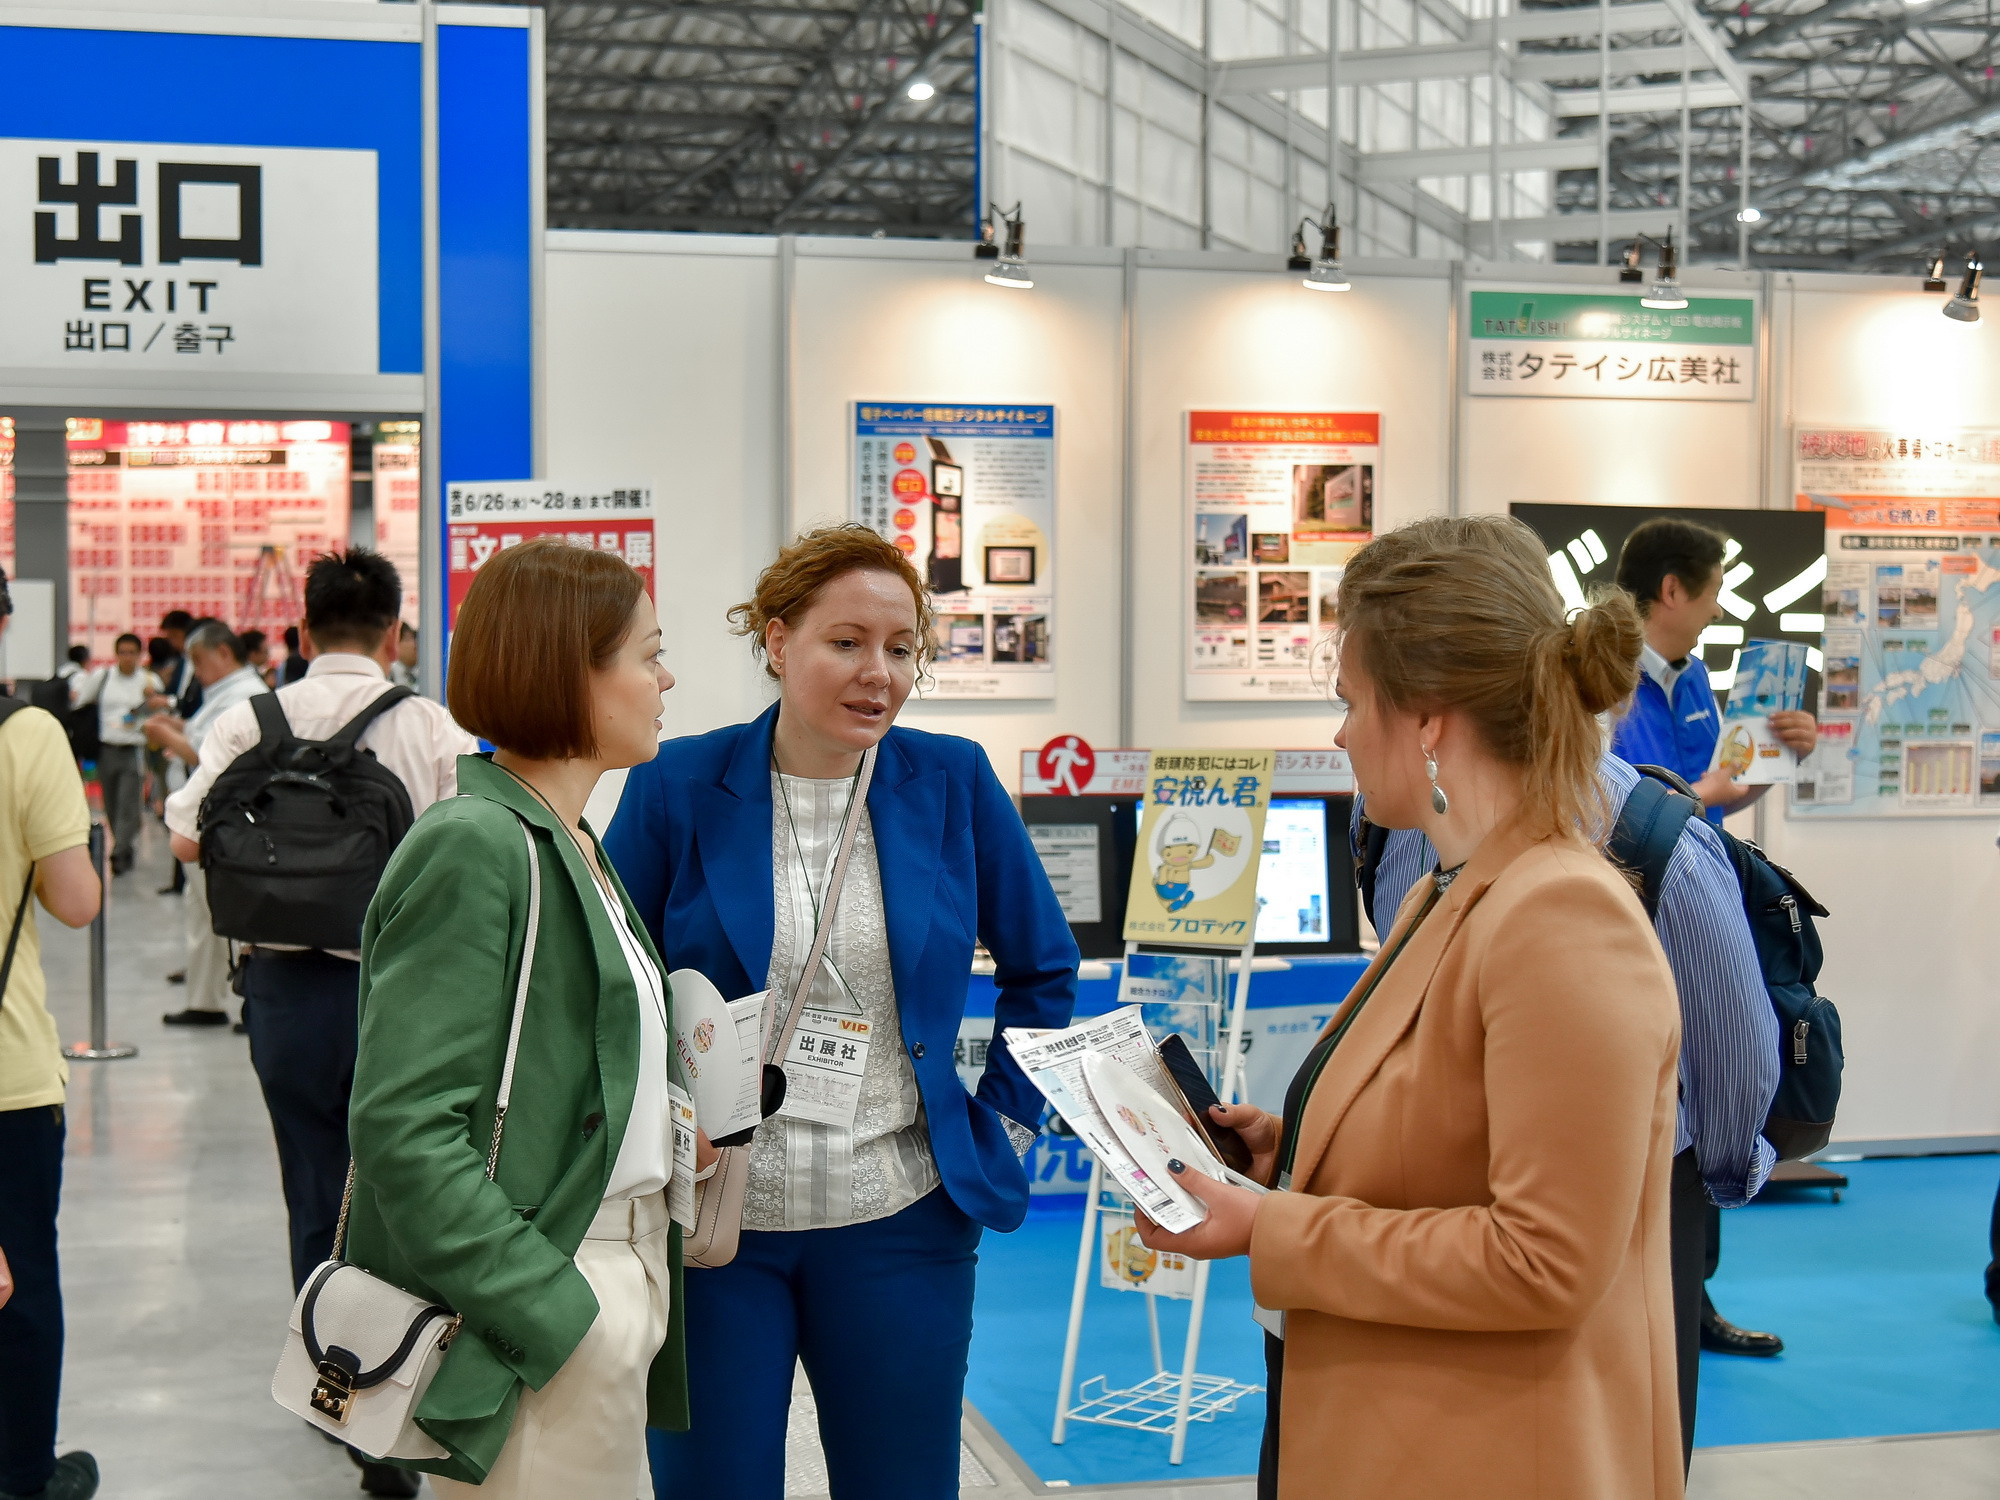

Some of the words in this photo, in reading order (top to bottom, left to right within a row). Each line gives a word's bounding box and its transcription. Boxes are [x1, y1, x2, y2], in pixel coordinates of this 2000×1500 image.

[34, 152, 263, 267] 出口
[83, 278, 218, 313] EXIT
[1517, 352, 1741, 384] タテイシ広美社
[840, 1020, 868, 1033] VIP
[799, 1035, 857, 1061] 出展社
[807, 1055, 844, 1067] EXHIBITOR
[681, 1106, 693, 1119] VIP
[671, 1126, 691, 1152] 展社
